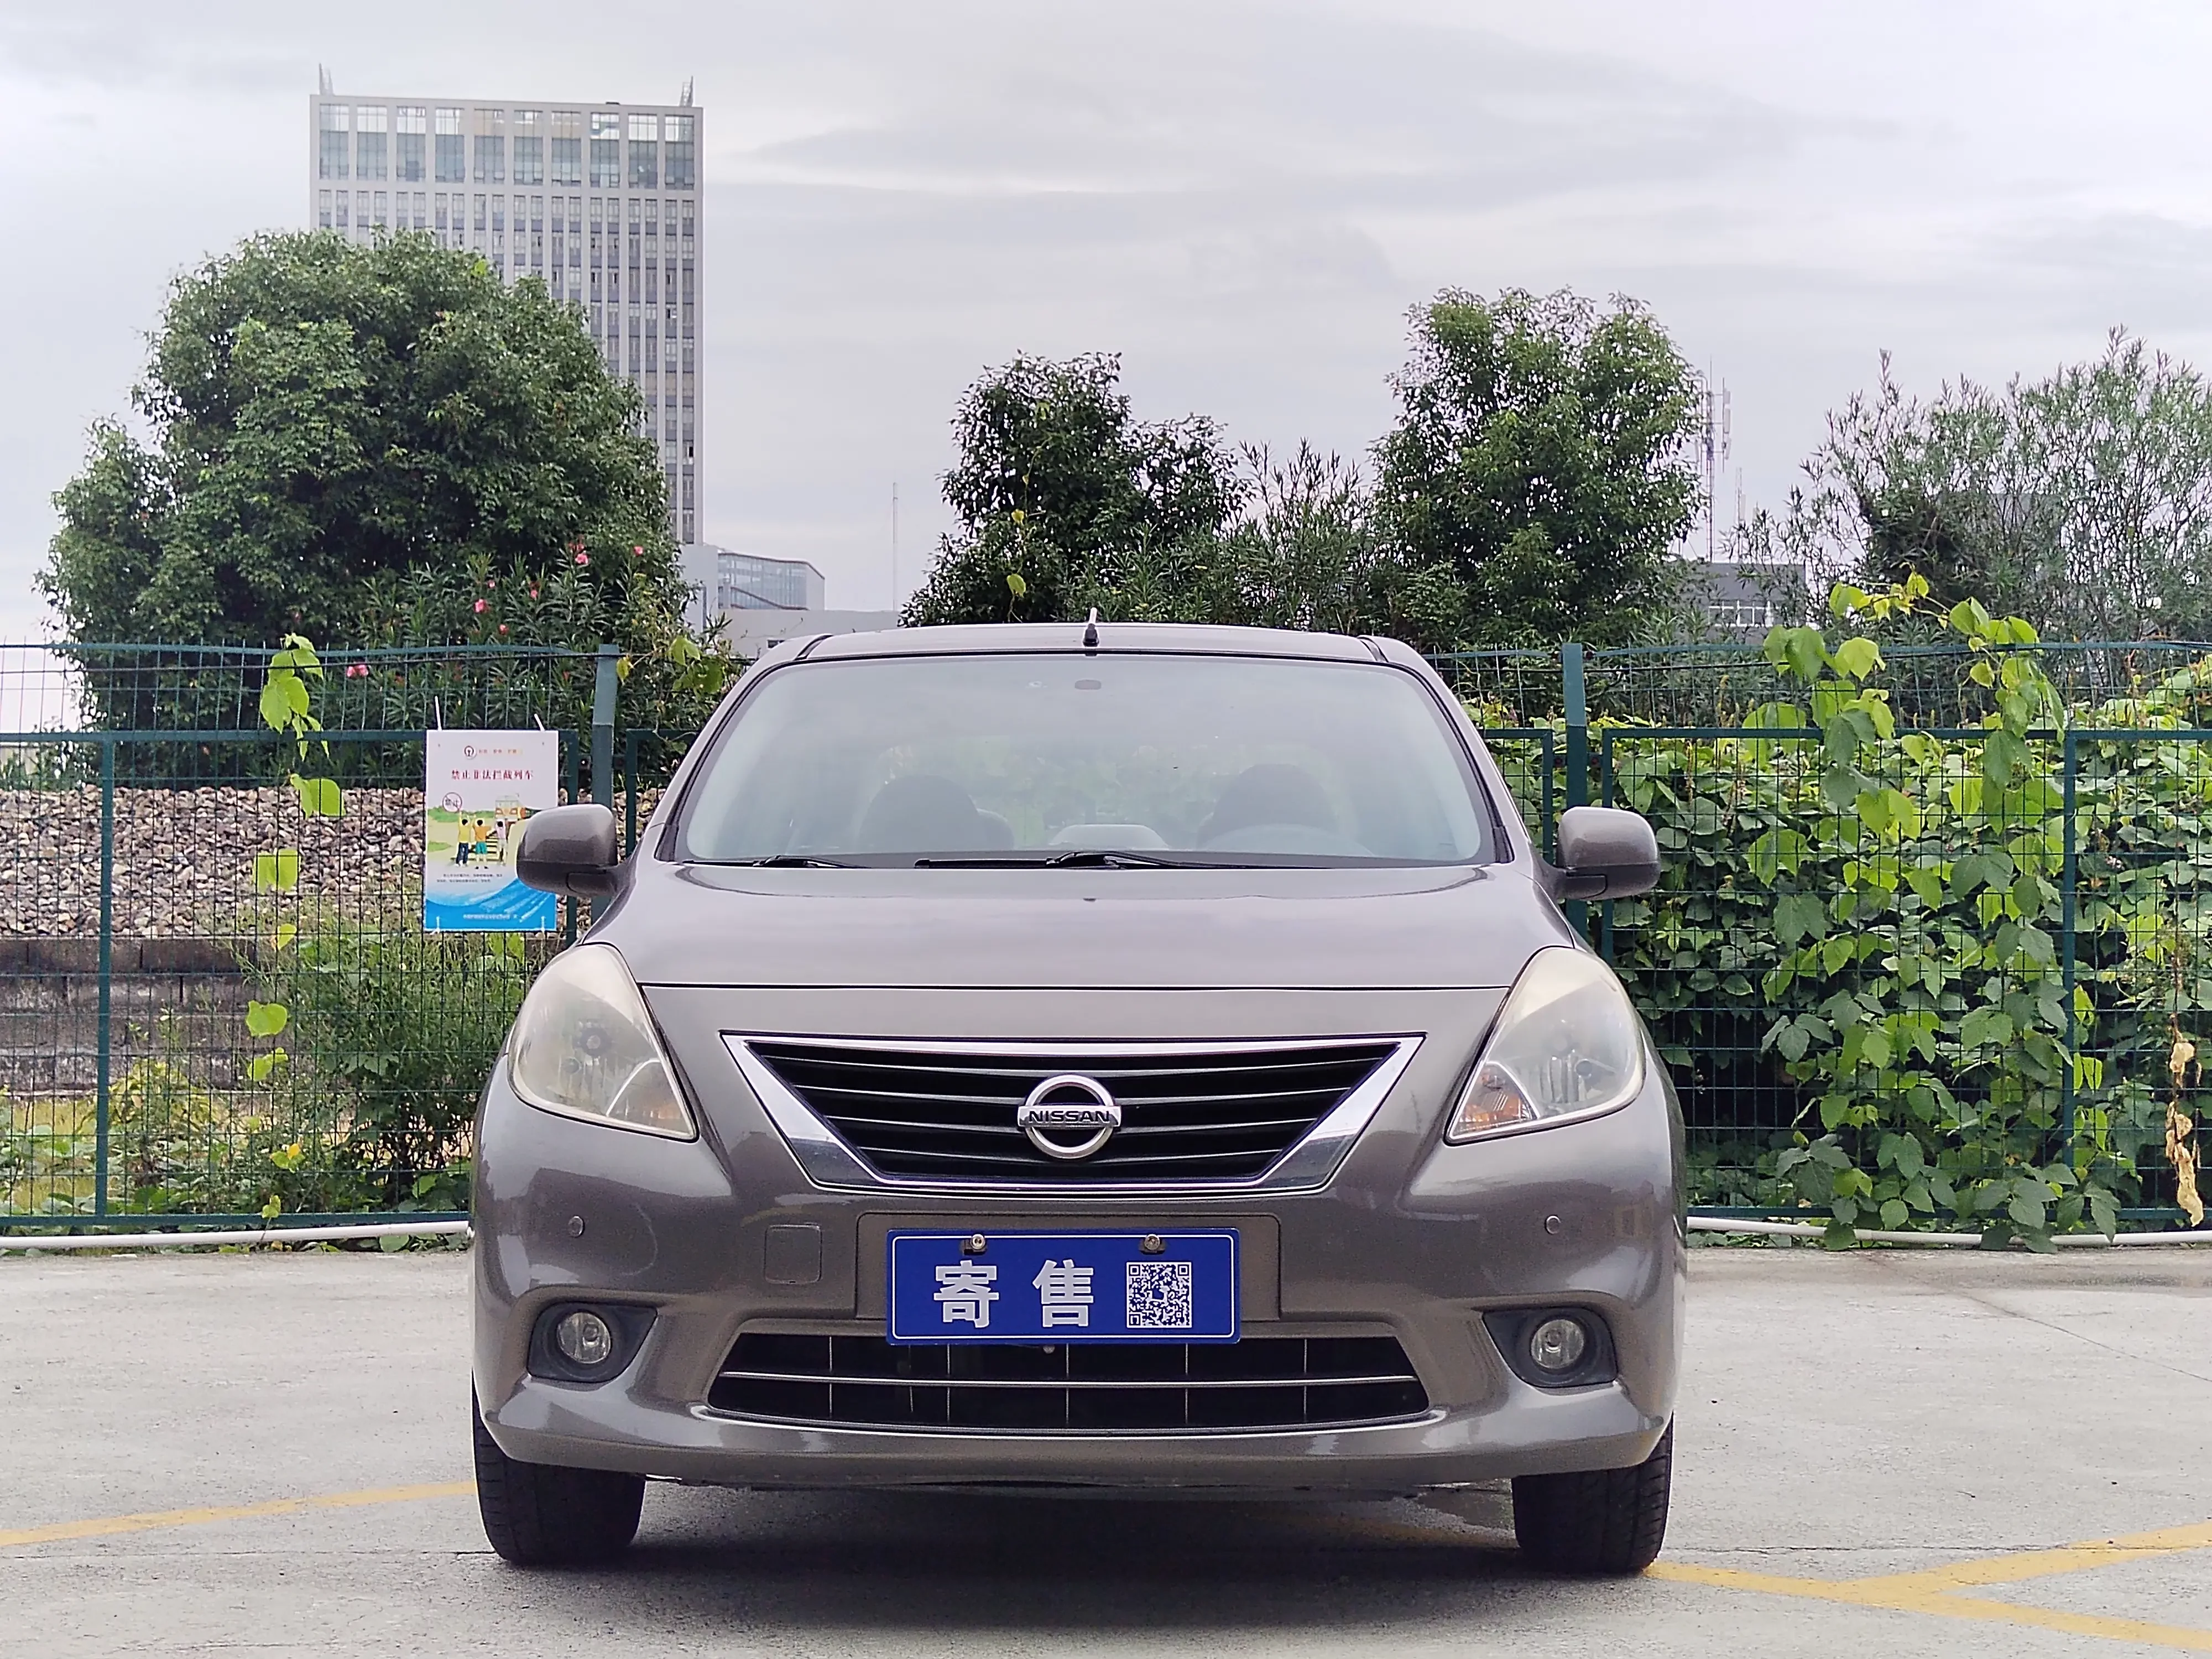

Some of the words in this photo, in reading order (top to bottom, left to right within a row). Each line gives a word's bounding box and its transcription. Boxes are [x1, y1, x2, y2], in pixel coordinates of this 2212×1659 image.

[451, 769, 534, 780] 禁止非法拦截列车
[1029, 1110, 1110, 1123] NISSAN
[933, 1259, 1094, 1328] 寄售
